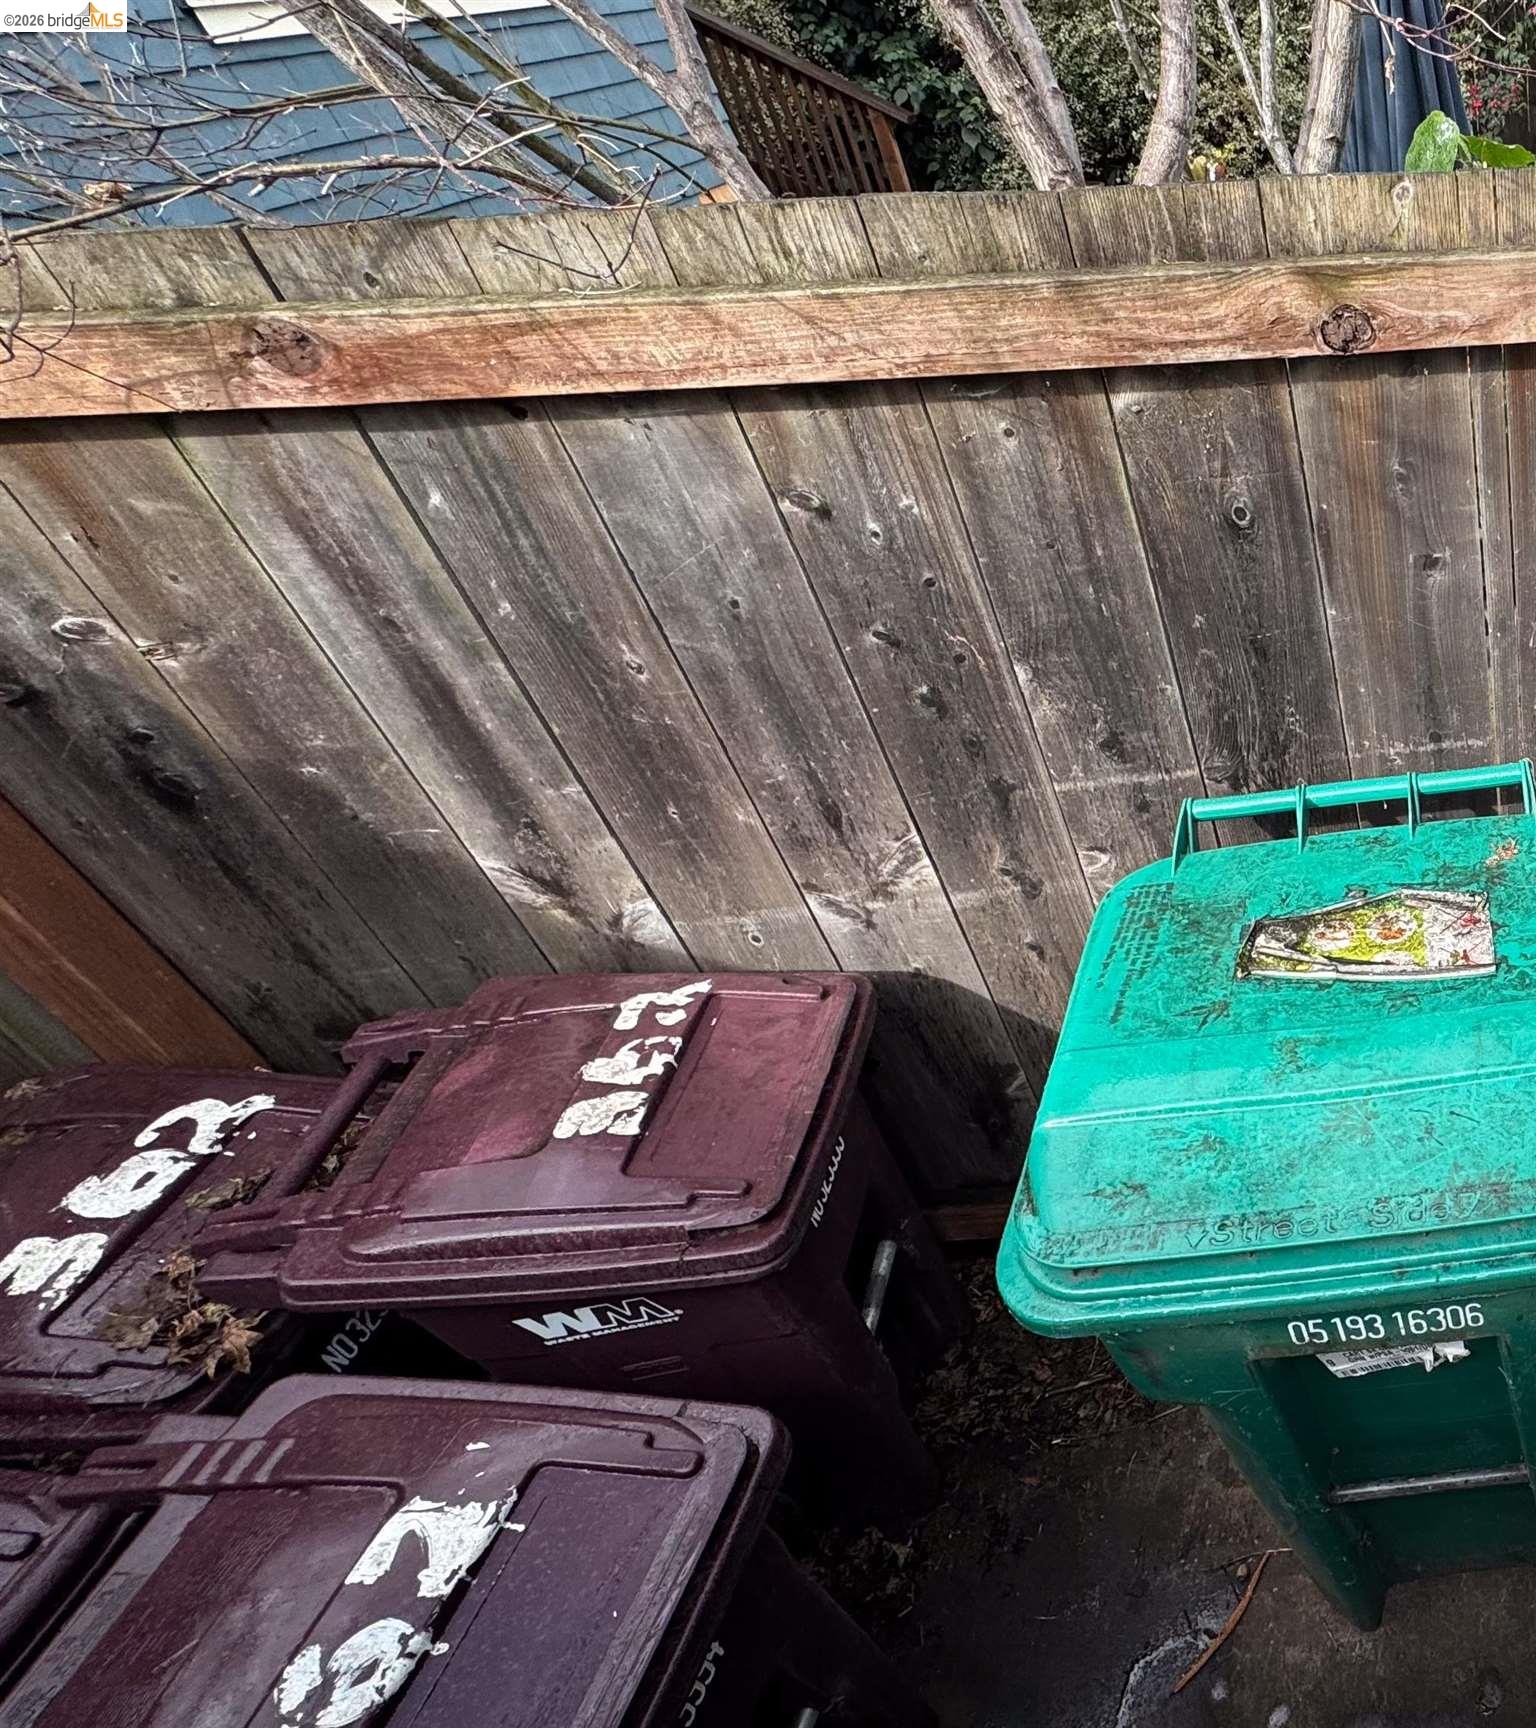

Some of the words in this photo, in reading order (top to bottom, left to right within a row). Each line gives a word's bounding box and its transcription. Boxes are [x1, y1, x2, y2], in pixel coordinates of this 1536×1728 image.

[353, 1307, 389, 1345] 32
[1287, 1313, 1385, 1346] 05193
[1391, 1303, 1485, 1337] 16306
